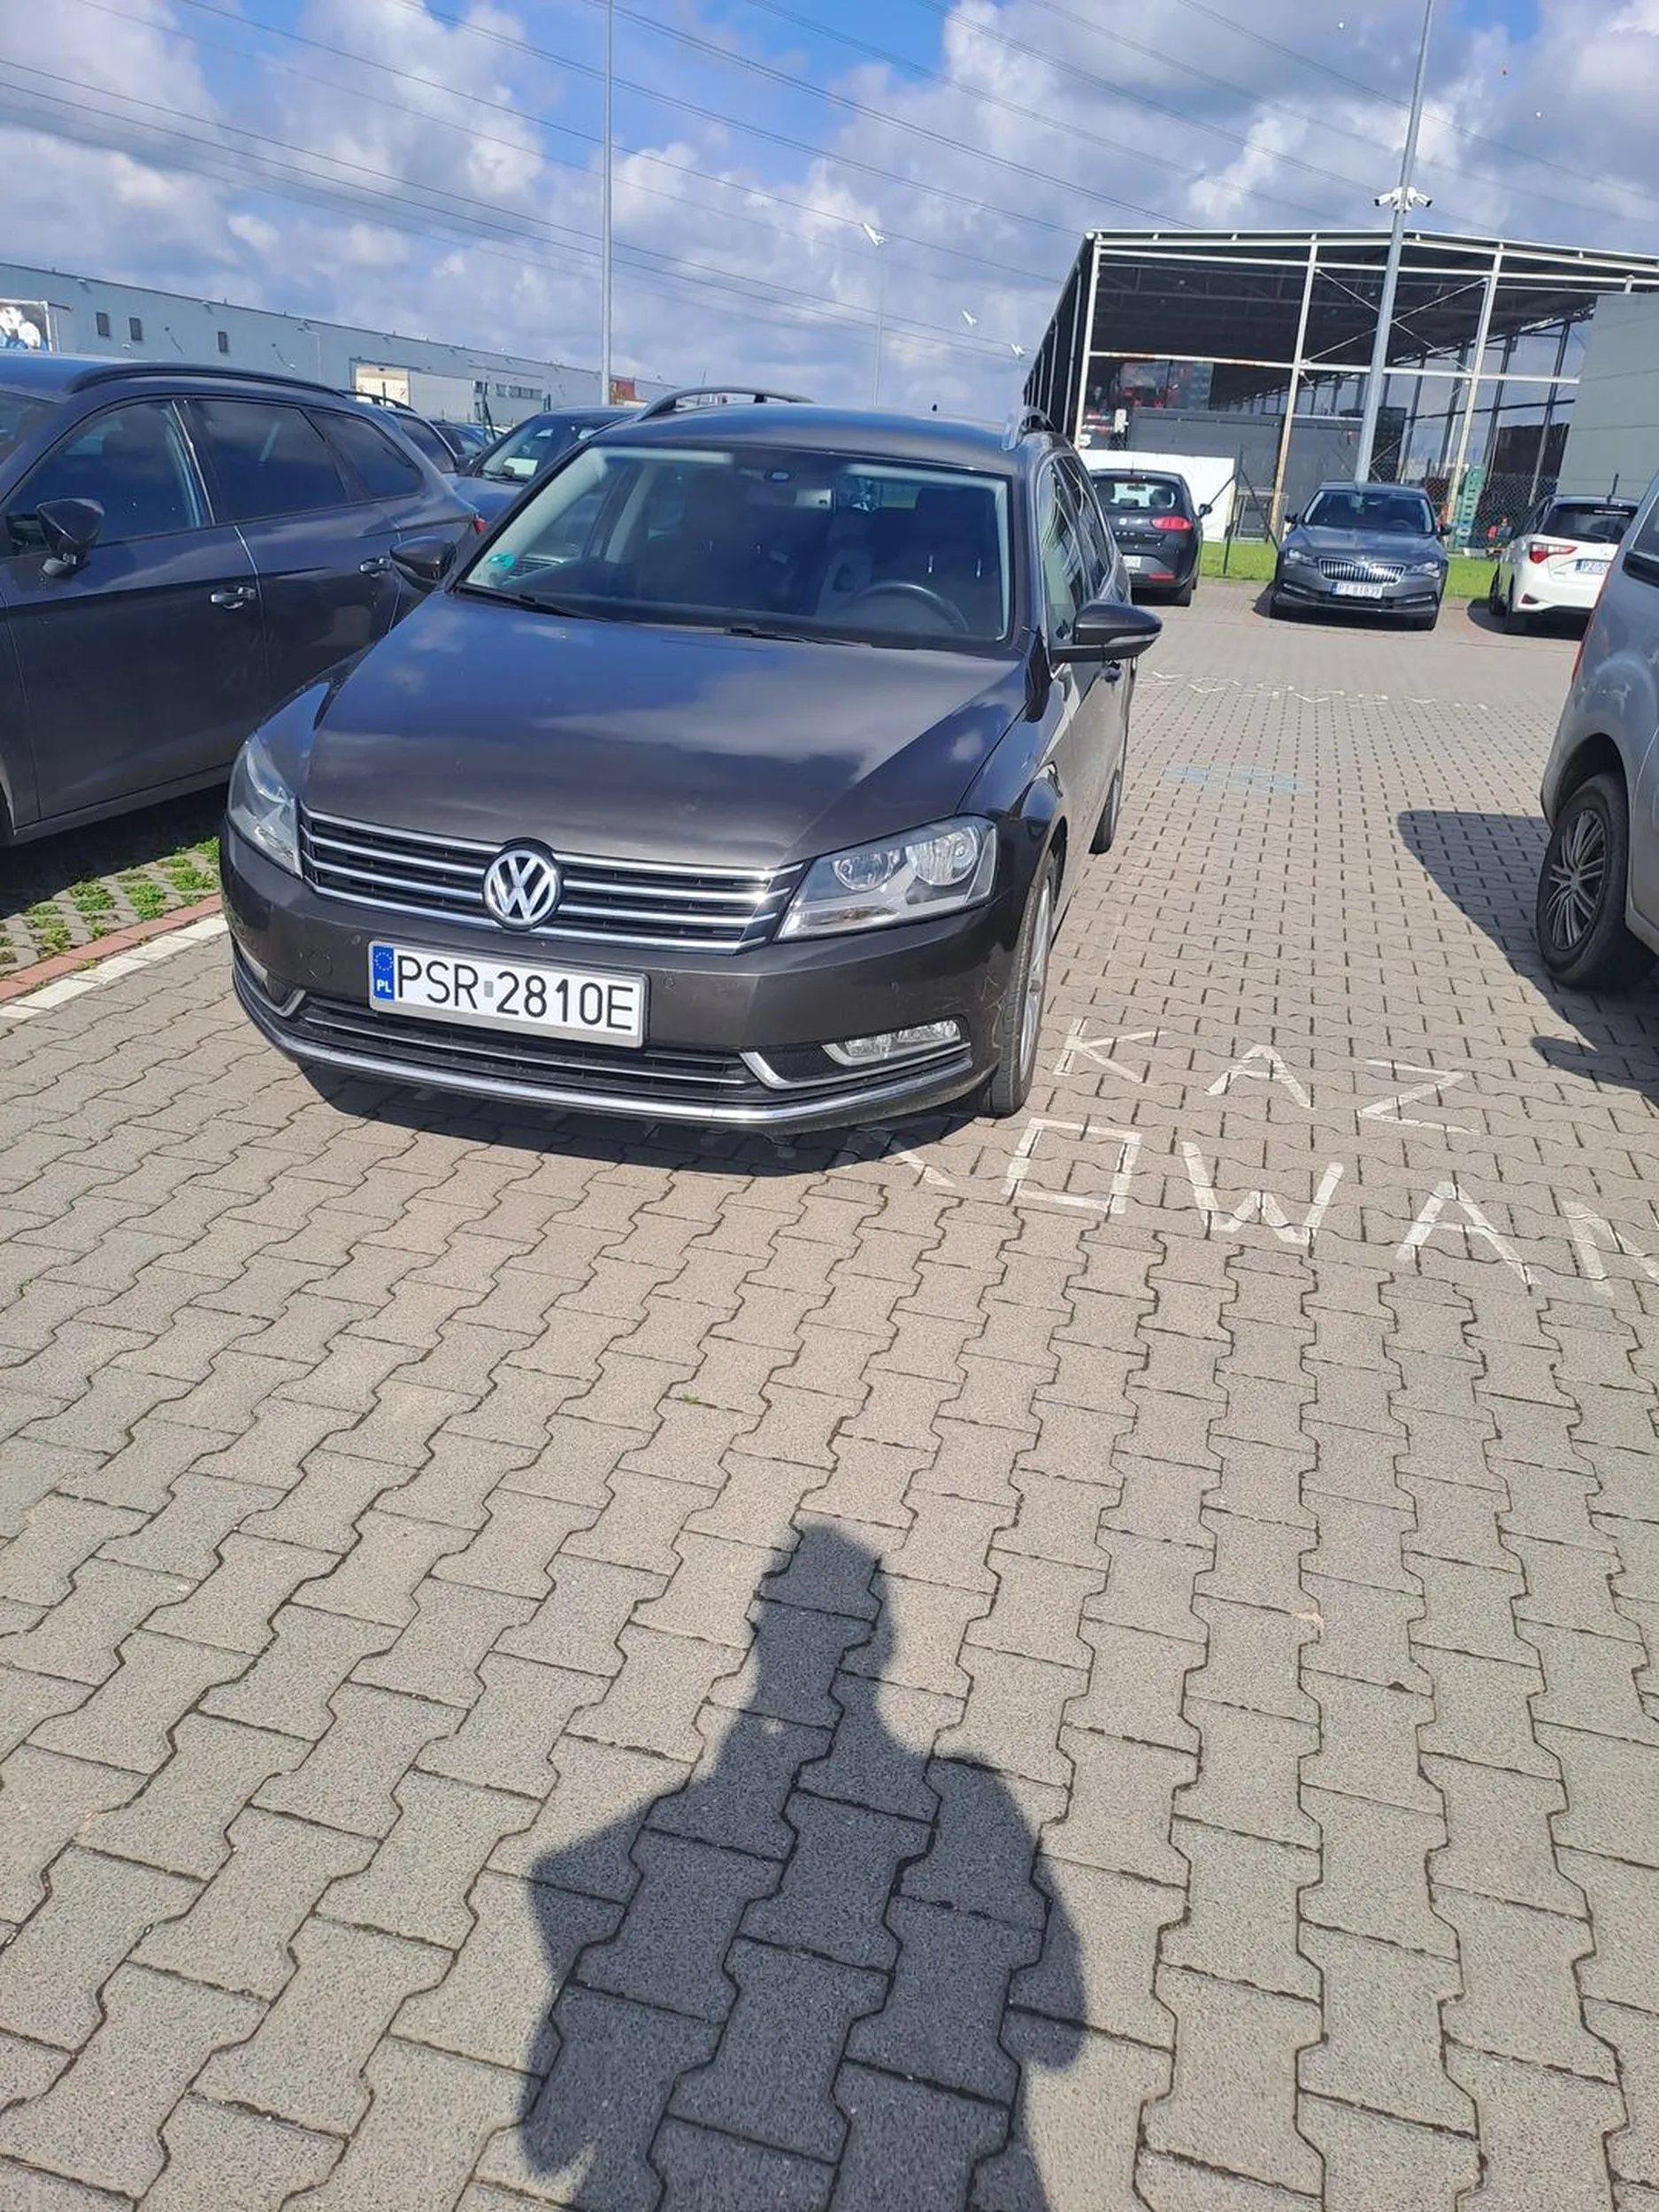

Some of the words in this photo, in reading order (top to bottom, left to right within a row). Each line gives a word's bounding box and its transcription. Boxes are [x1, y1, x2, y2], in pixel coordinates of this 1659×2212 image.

[377, 979, 392, 993] PL
[397, 955, 479, 1010] PSR
[496, 971, 634, 1032] 2810E
